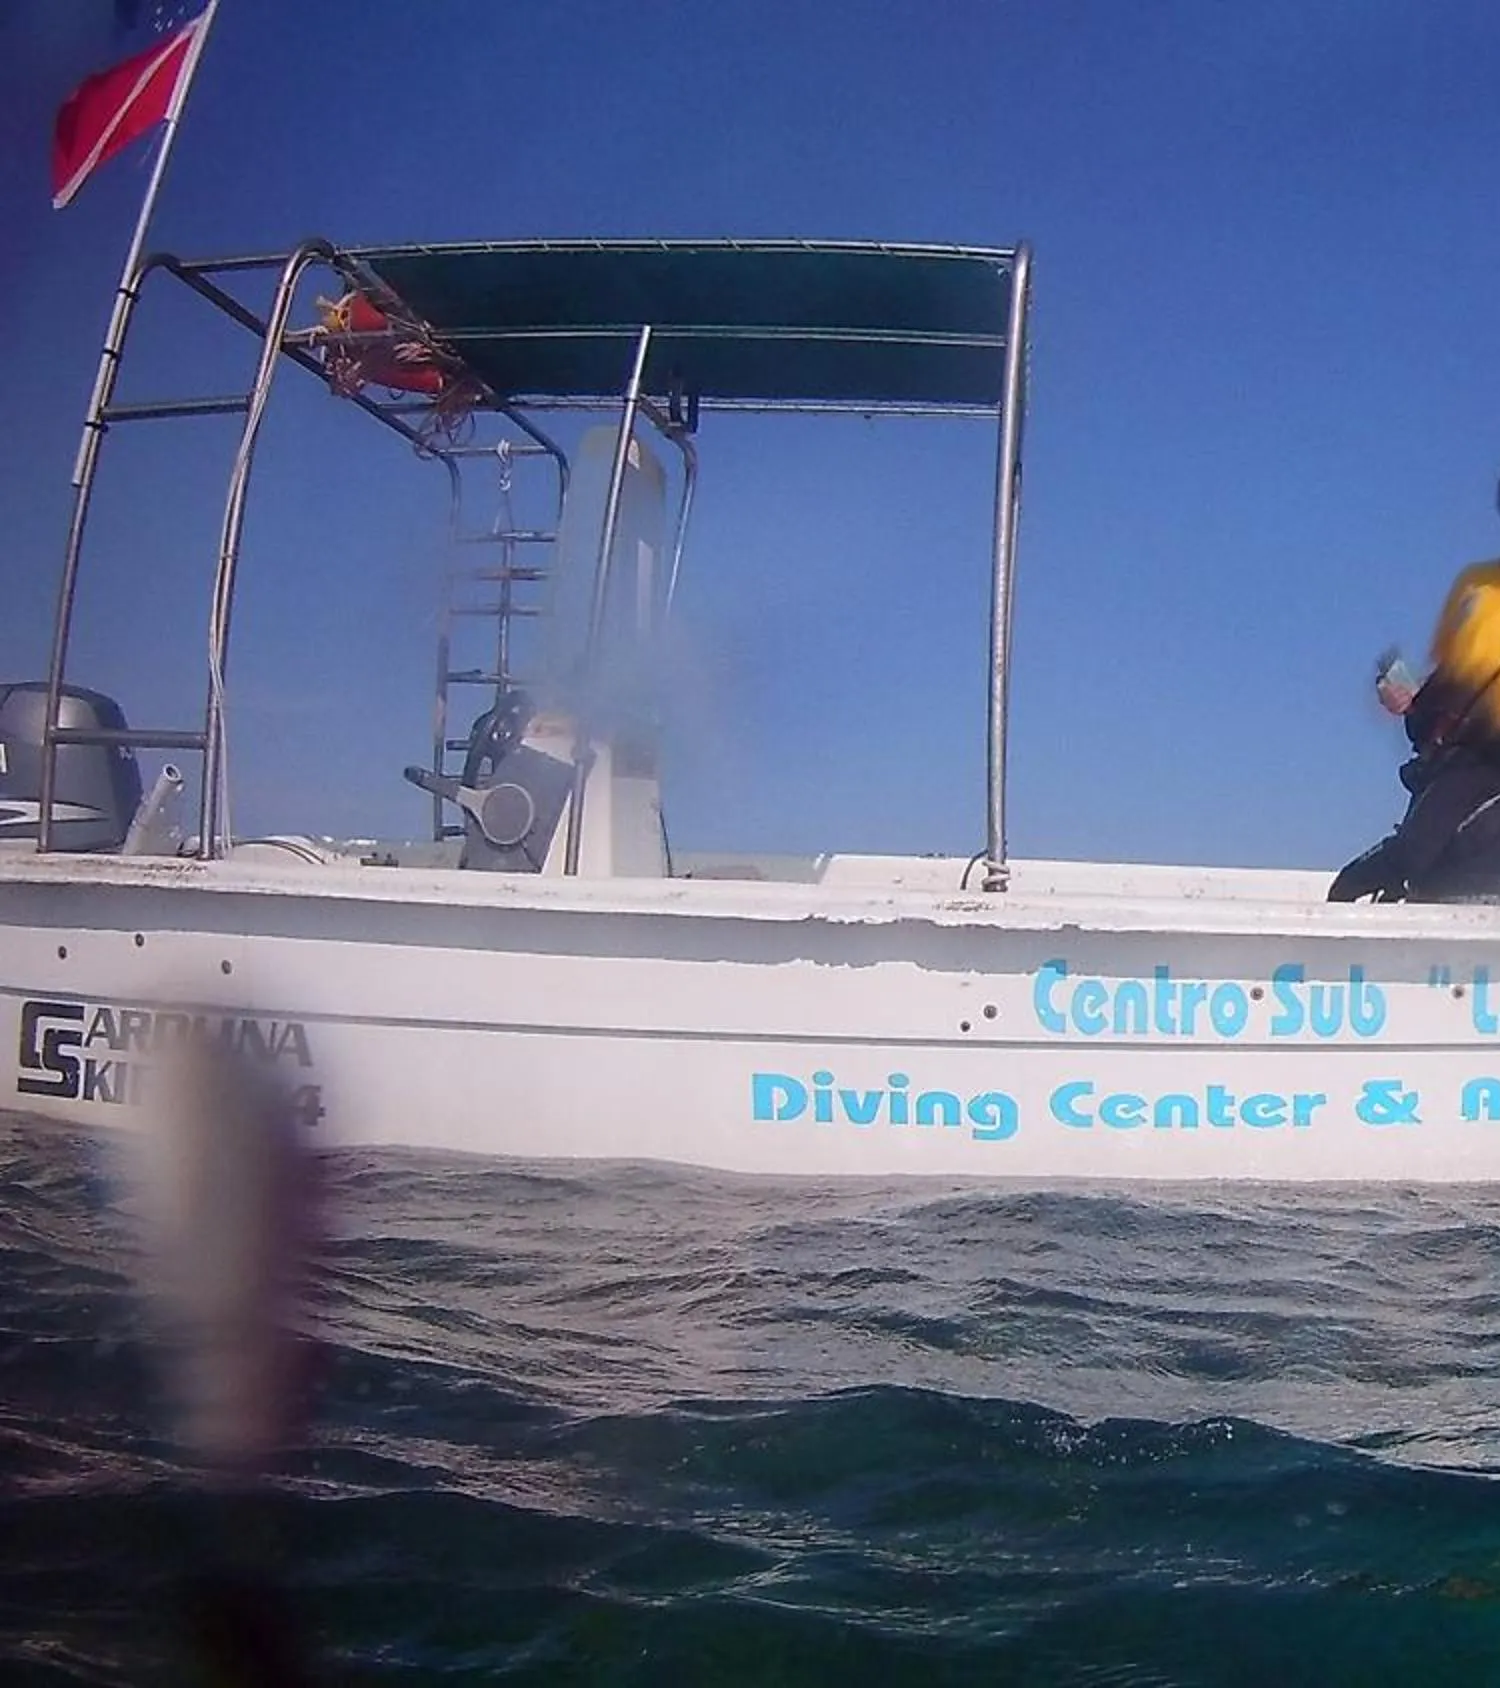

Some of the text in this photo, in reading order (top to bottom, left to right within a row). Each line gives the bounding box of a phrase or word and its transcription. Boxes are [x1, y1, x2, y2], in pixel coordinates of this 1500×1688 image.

[1033, 959, 1249, 1038] Centro
[1270, 963, 1387, 1039] Sub
[751, 1070, 1020, 1141] Diving
[1048, 1080, 1327, 1130] Center
[1355, 1079, 1421, 1127] &
